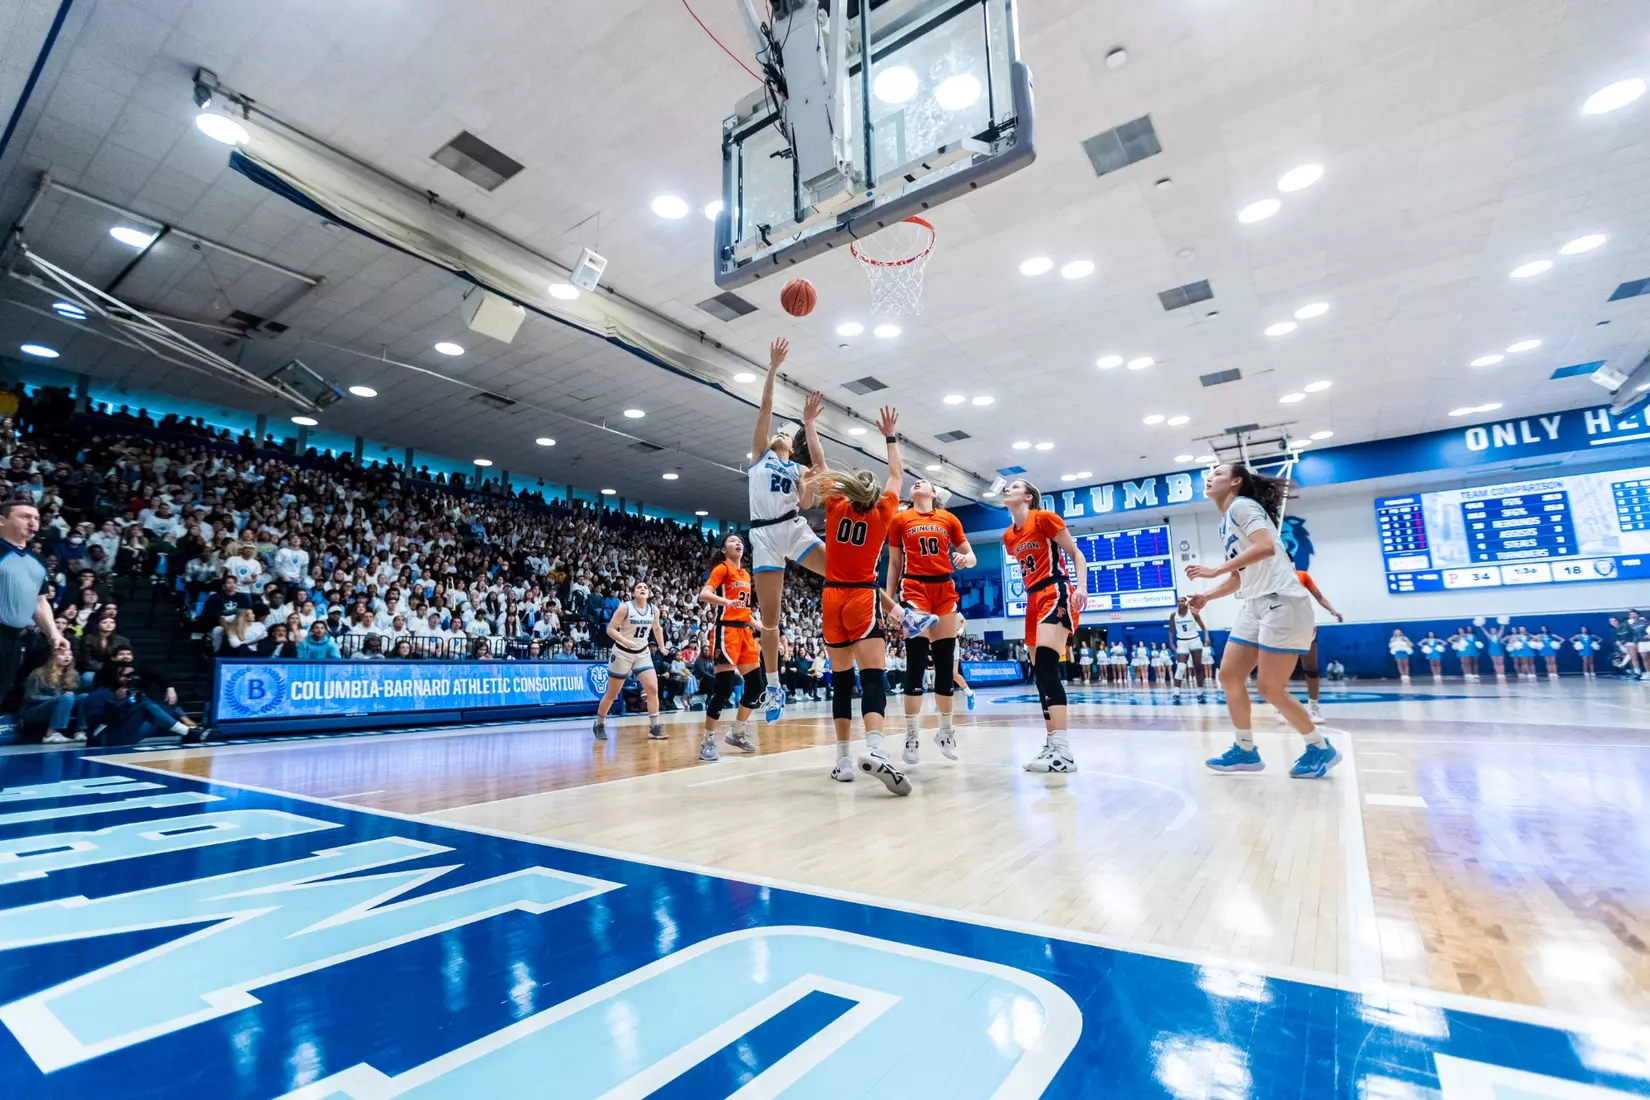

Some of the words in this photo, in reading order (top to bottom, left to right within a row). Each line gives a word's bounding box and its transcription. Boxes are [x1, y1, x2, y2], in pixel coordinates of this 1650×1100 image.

[1465, 415, 1561, 451] ONLY
[770, 473, 792, 494] 20
[1461, 490, 1489, 499] TEAM
[836, 516, 868, 547] 00
[918, 536, 939, 556] 10
[1471, 572, 1491, 581] 34
[1564, 566, 1582, 575] 18
[633, 626, 647, 638] 15
[247, 678, 266, 700] B
[290, 679, 450, 700] COLUMBIA-BARNARD
[452, 677, 511, 696] ATHLETIC
[513, 676, 584, 693] CONSORTIUM
